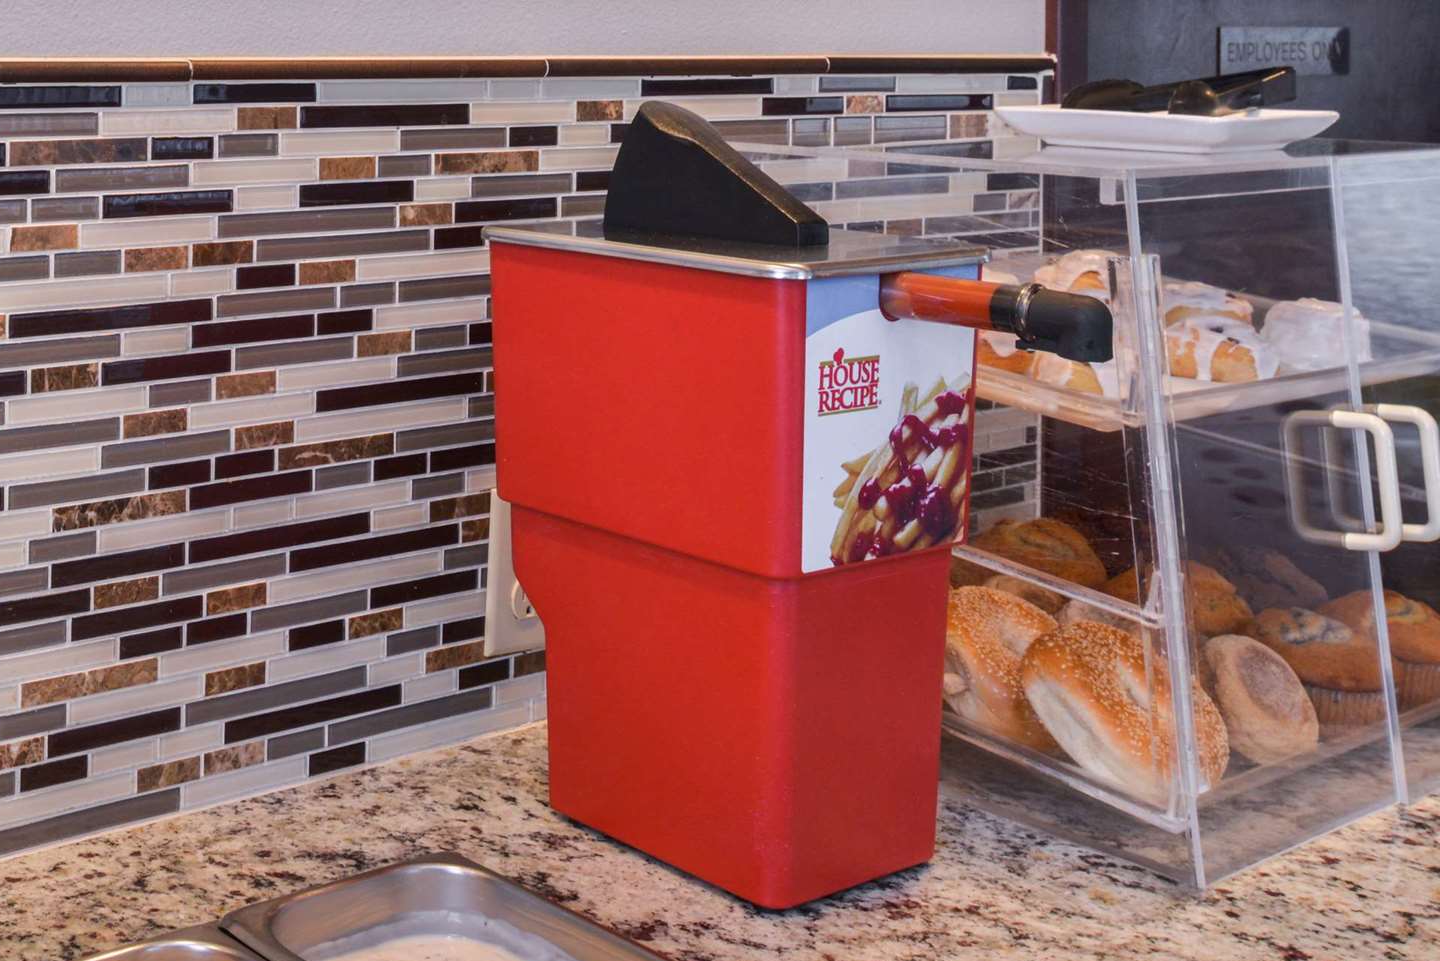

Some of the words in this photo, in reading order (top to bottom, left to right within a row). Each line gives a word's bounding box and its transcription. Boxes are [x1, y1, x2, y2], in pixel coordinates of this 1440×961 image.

[1227, 41, 1307, 62] EMPLOYEES
[818, 360, 879, 390] HOUSE
[818, 383, 878, 412] RECIPE
